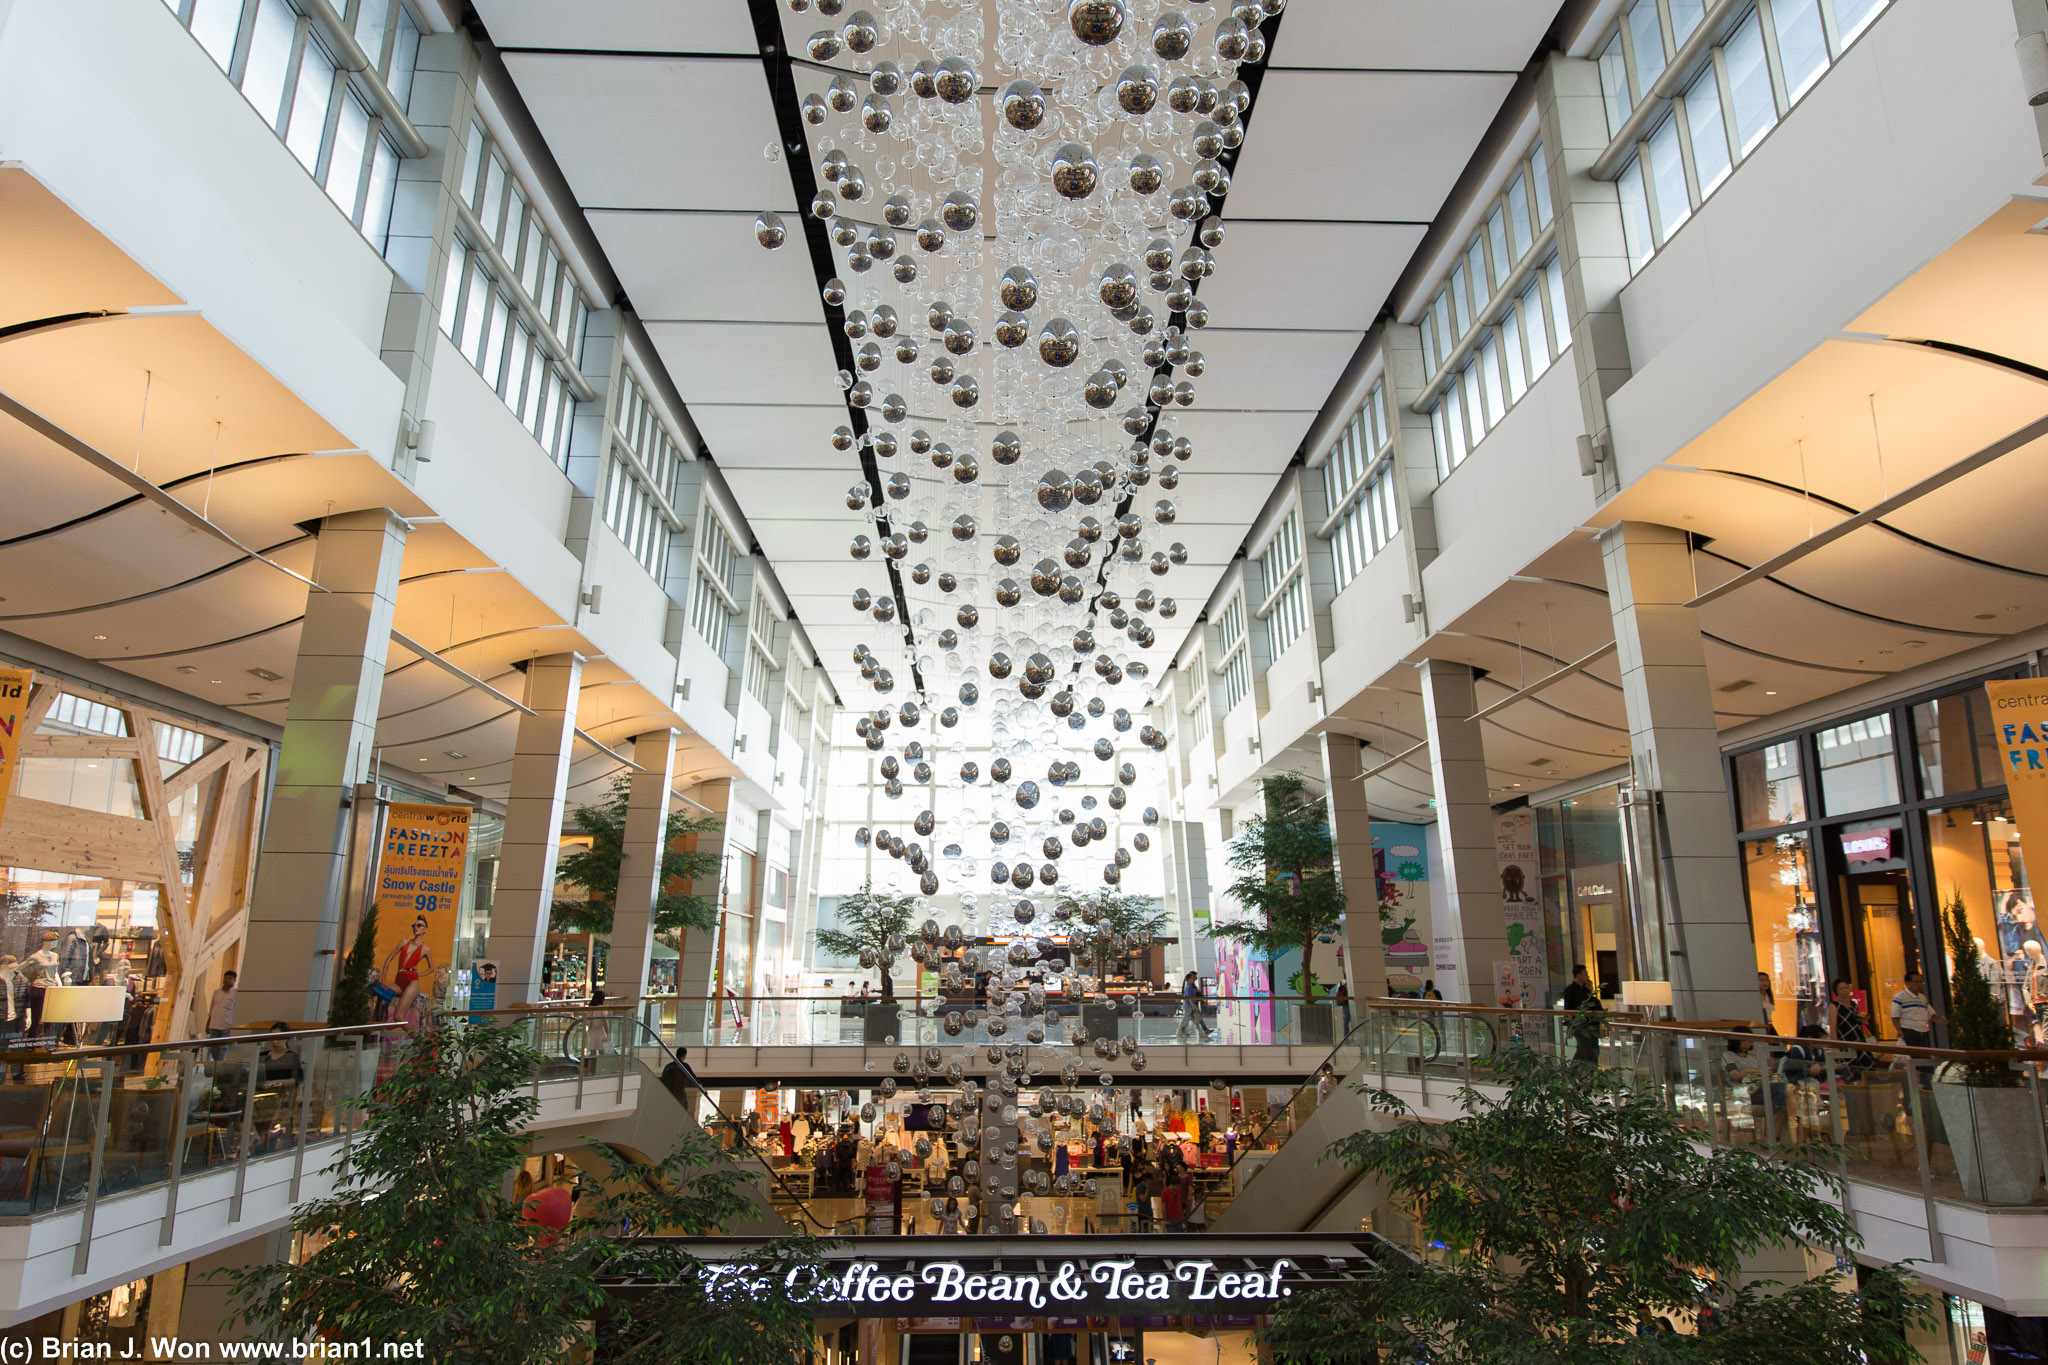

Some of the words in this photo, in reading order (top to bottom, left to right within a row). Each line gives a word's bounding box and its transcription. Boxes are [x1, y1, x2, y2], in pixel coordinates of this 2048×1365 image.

[2009, 748, 2048, 771] FR
[389, 827, 465, 844] FASHION
[387, 842, 462, 859] FREEZTA
[1498, 851, 1517, 859] IDEAS
[1518, 851, 1535, 859] FREE
[382, 877, 416, 890] Snow
[419, 880, 456, 894] Castle
[414, 894, 438, 912] 98
[784, 1263, 915, 1302] Coffee
[921, 1261, 1047, 1309] Bean
[1050, 1261, 1088, 1300] &
[1090, 1260, 1170, 1300] Tea
[1174, 1260, 1292, 1300] Leaf.
